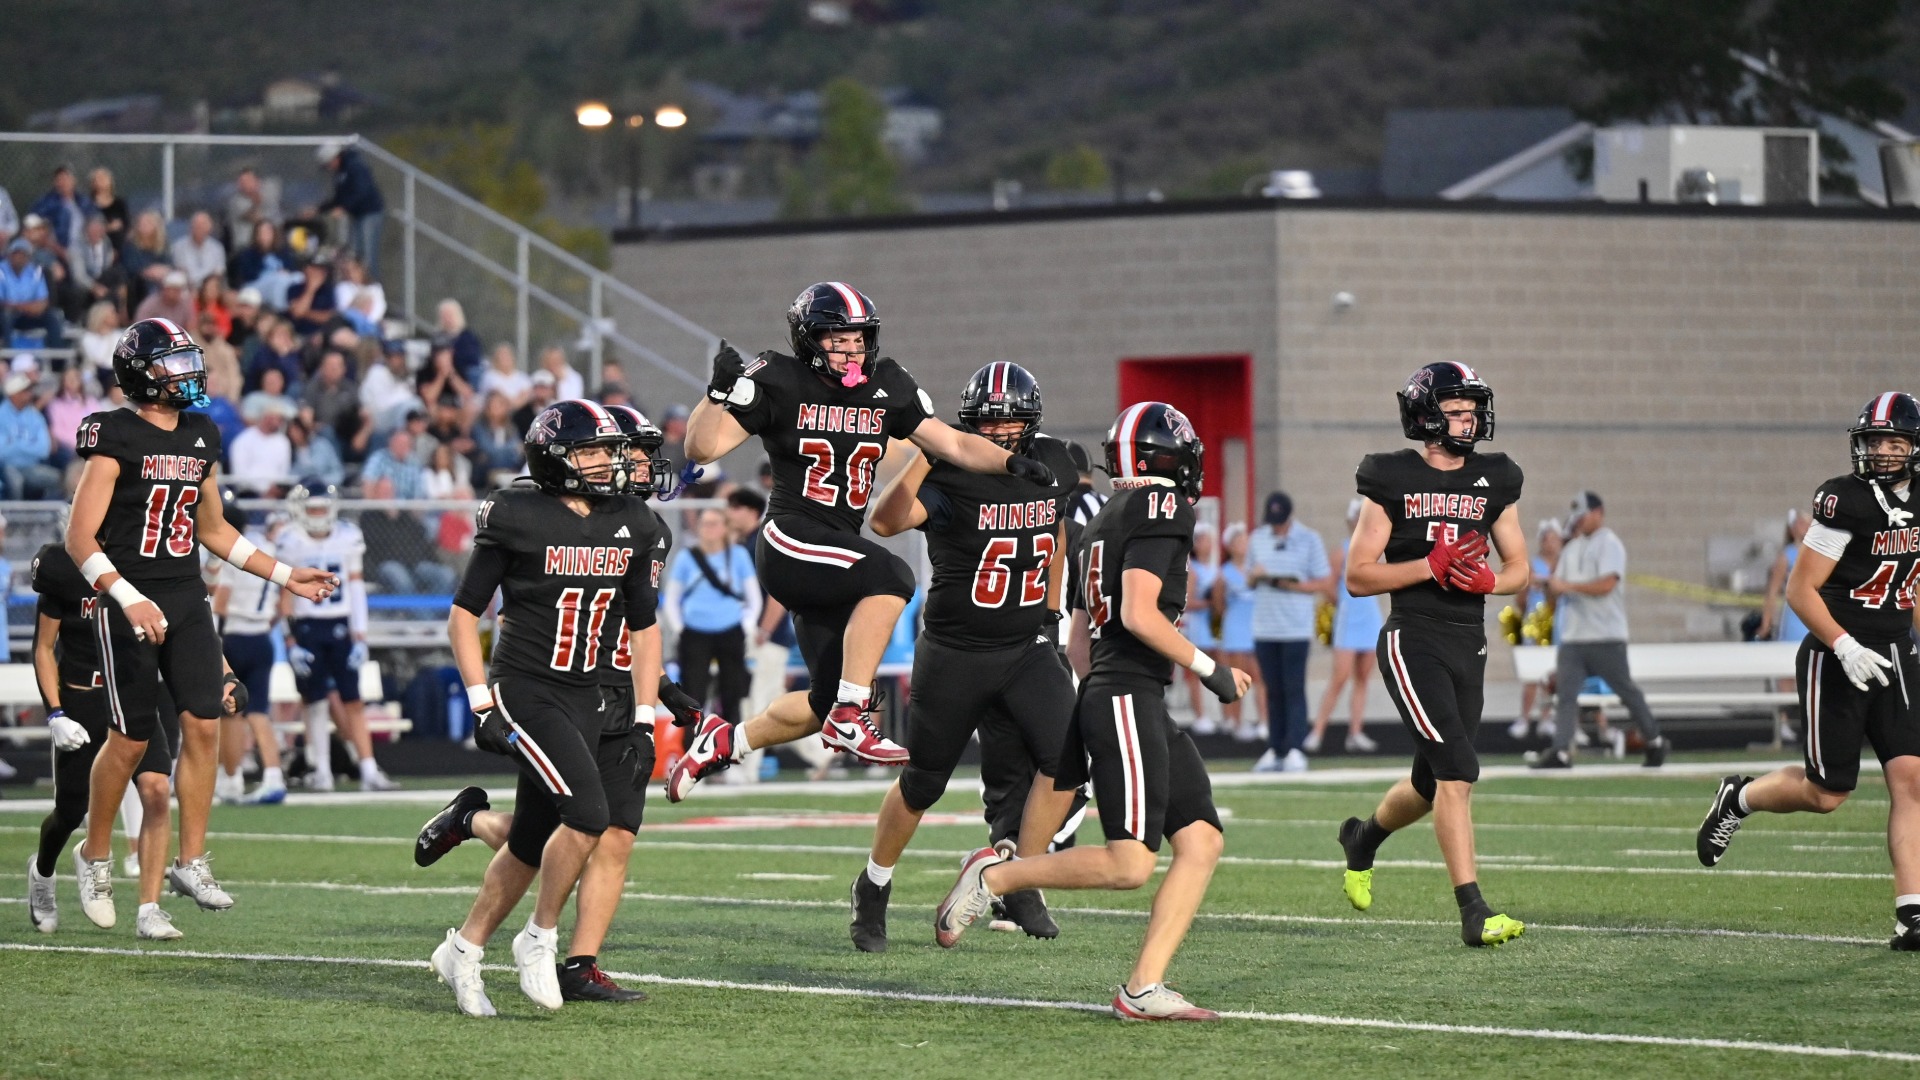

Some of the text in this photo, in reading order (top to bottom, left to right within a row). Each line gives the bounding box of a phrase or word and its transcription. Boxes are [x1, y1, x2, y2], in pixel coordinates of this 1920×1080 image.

[797, 404, 886, 434] MINERS
[80, 423, 101, 448] 16
[141, 455, 206, 482] MINERS
[799, 438, 883, 510] 20
[978, 499, 1056, 530] MINERS
[1147, 492, 1177, 519] 14
[1404, 493, 1487, 520] MINERS
[140, 484, 198, 558] 16
[545, 546, 633, 576] MINERS
[971, 533, 1055, 608] 62
[550, 588, 616, 672] 11
